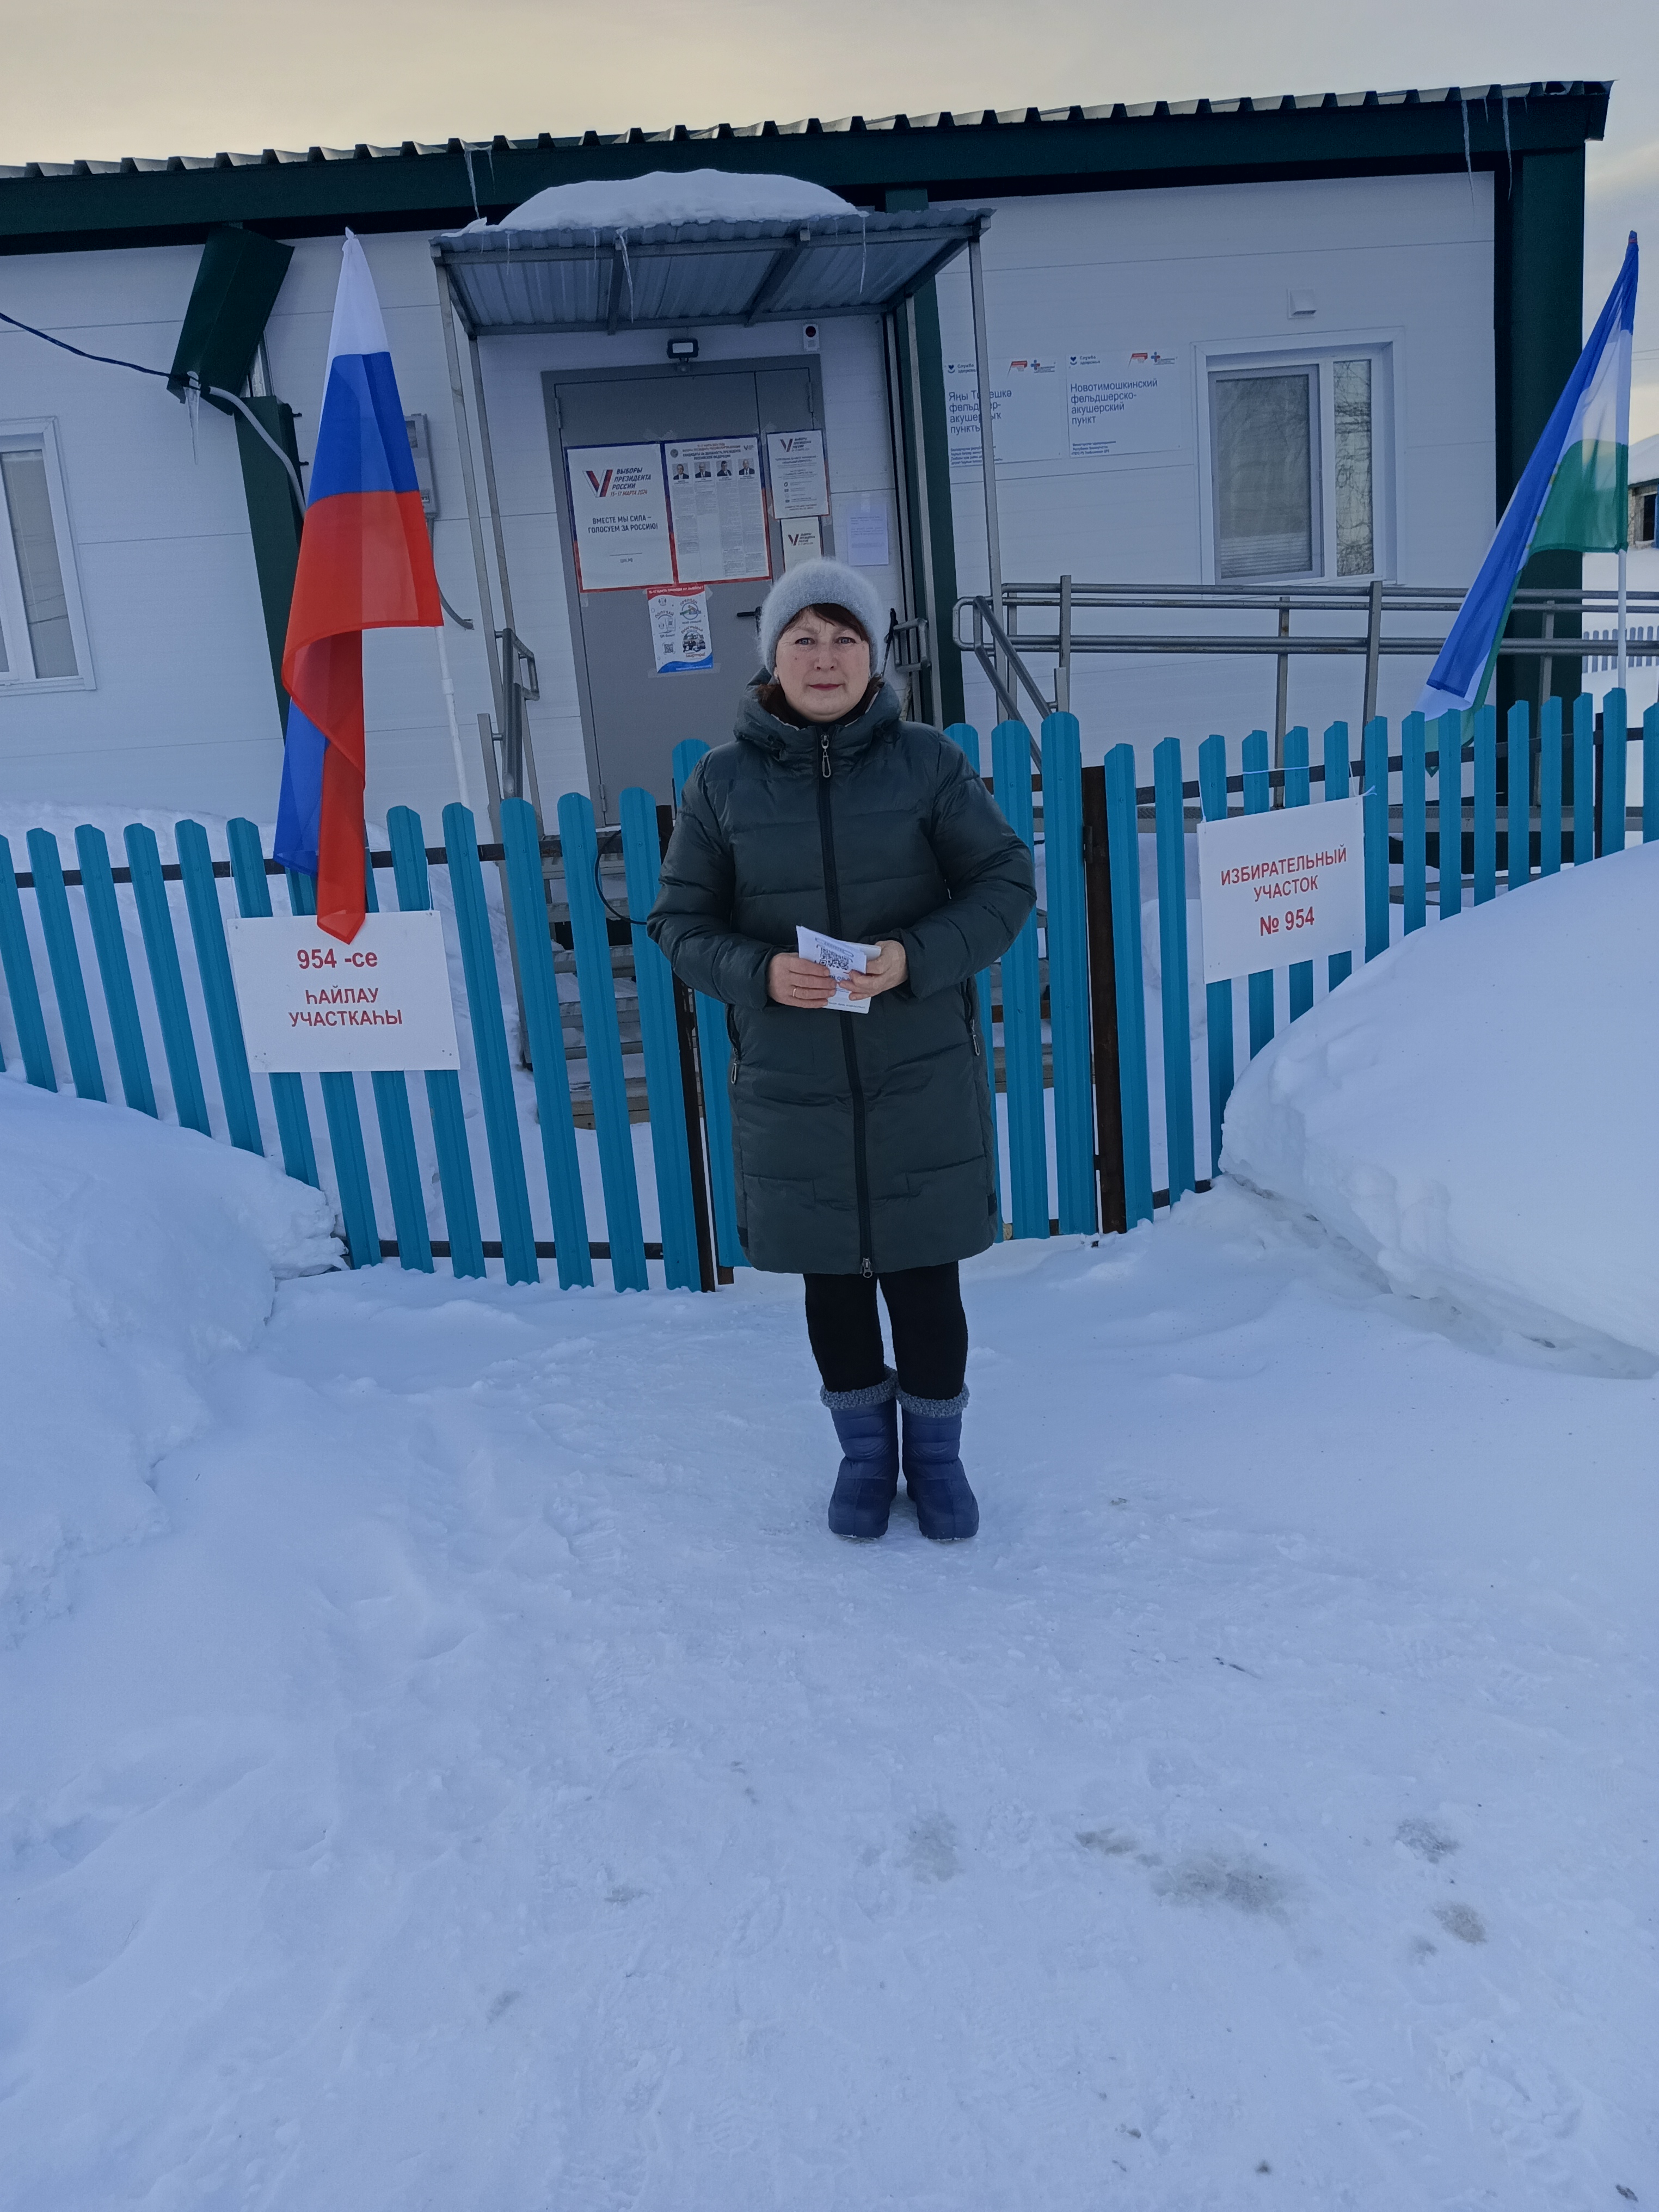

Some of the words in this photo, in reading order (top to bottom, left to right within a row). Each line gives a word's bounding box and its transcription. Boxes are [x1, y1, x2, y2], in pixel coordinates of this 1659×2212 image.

[1070, 378, 1157, 393] Новотимошкинский
[949, 392, 968, 402] Яңы
[1071, 392, 1137, 405] фельдшерско-
[1071, 402, 1125, 415] акушерский
[1072, 416, 1096, 427] пункт
[614, 474, 652, 482] ПРЕЗИДЕНТА
[592, 516, 616, 525] ВМЕСТЕ
[630, 514, 646, 523] СИЛА
[588, 525, 620, 533] ГОЛОСУЕМ
[630, 523, 658, 531] РОССИЮ!
[1220, 843, 1347, 886] ИЗБИРАТЕЛЬНЫЙ
[1253, 875, 1319, 902] УЧАСТОК
[1259, 915, 1280, 936] №
[1285, 906, 1315, 931] 954
[297, 948, 337, 969] 954
[344, 951, 378, 968] -се
